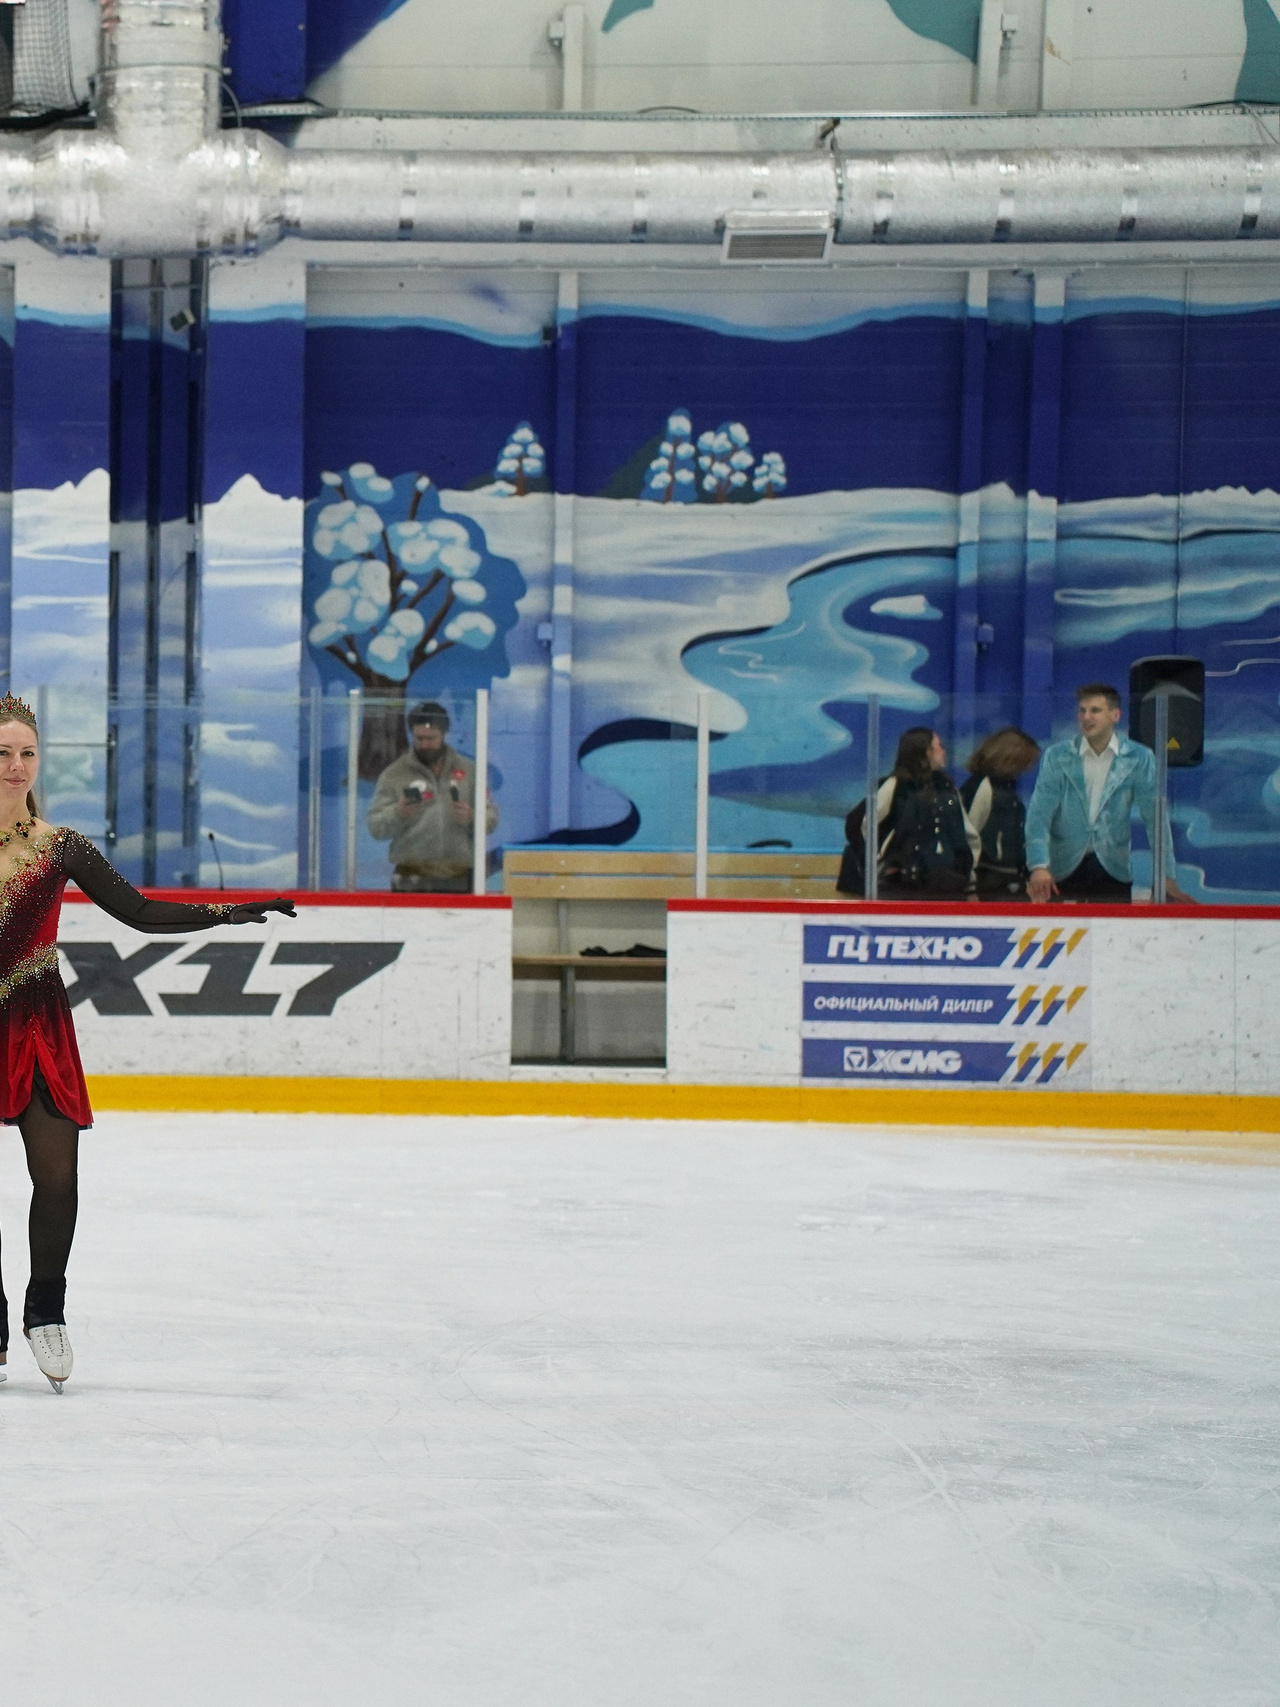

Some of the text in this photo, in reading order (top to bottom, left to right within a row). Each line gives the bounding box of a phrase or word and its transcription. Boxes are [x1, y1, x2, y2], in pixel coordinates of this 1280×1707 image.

[827, 934, 983, 963] ГЦ ТЕХНО
[813, 995, 994, 1015] ОФИЦИАЛЬНЫЙ ДИЛЕР
[872, 1049, 962, 1075] XCMG
